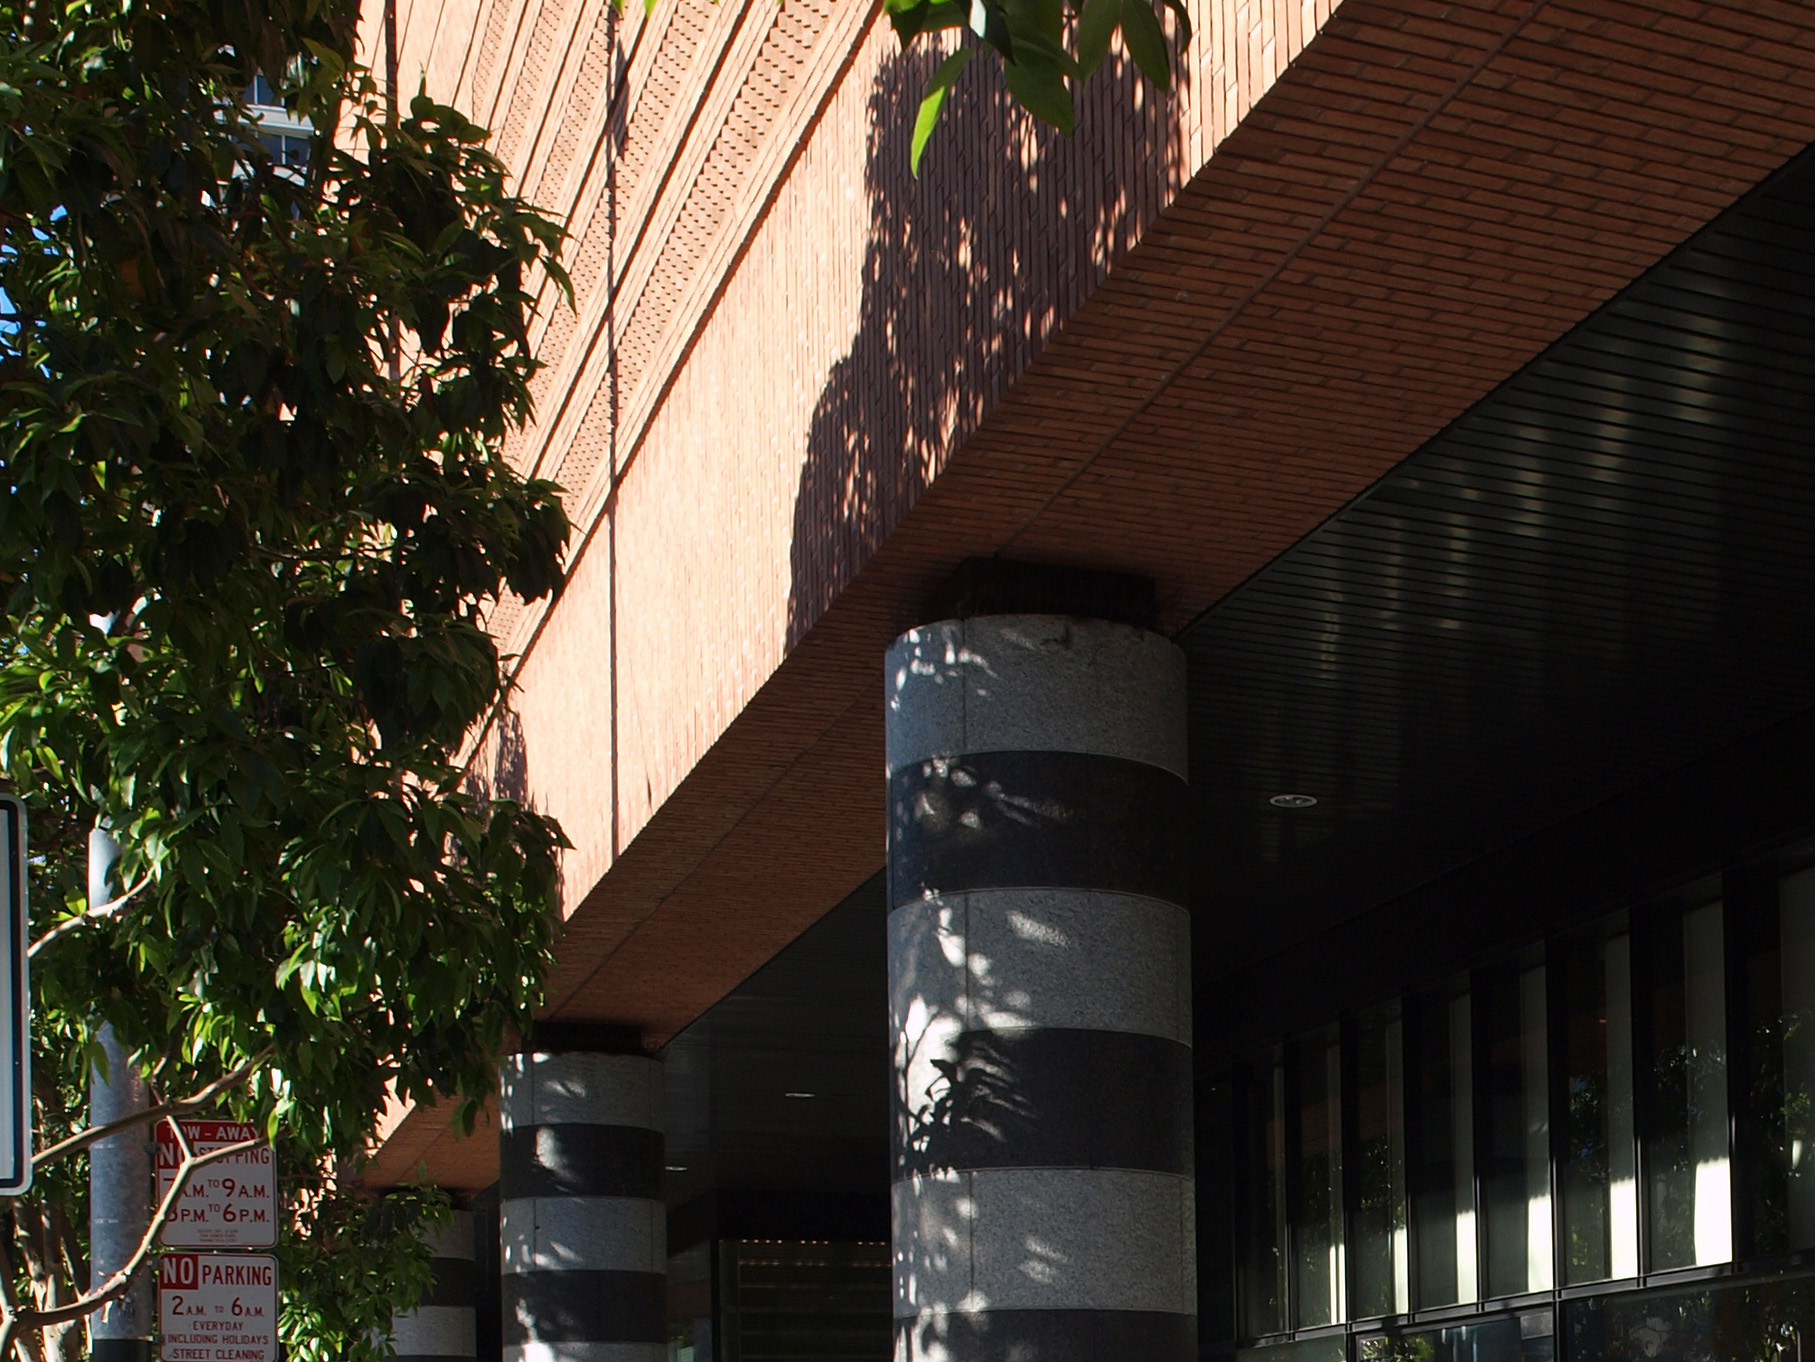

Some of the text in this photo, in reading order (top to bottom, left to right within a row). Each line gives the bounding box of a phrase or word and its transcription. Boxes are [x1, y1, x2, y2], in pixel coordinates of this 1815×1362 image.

[167, 1126, 200, 1139] TW
[208, 1179, 220, 1188] TO
[209, 1204, 220, 1213] TO
[163, 1257, 272, 1286] NO PARKING
[215, 1305, 224, 1313] TO
[193, 1321, 244, 1331] EVERYDAY
[168, 1334, 269, 1345] INCLUDING HOLIDAYS
[173, 1349, 265, 1360] STREET CLEANING
